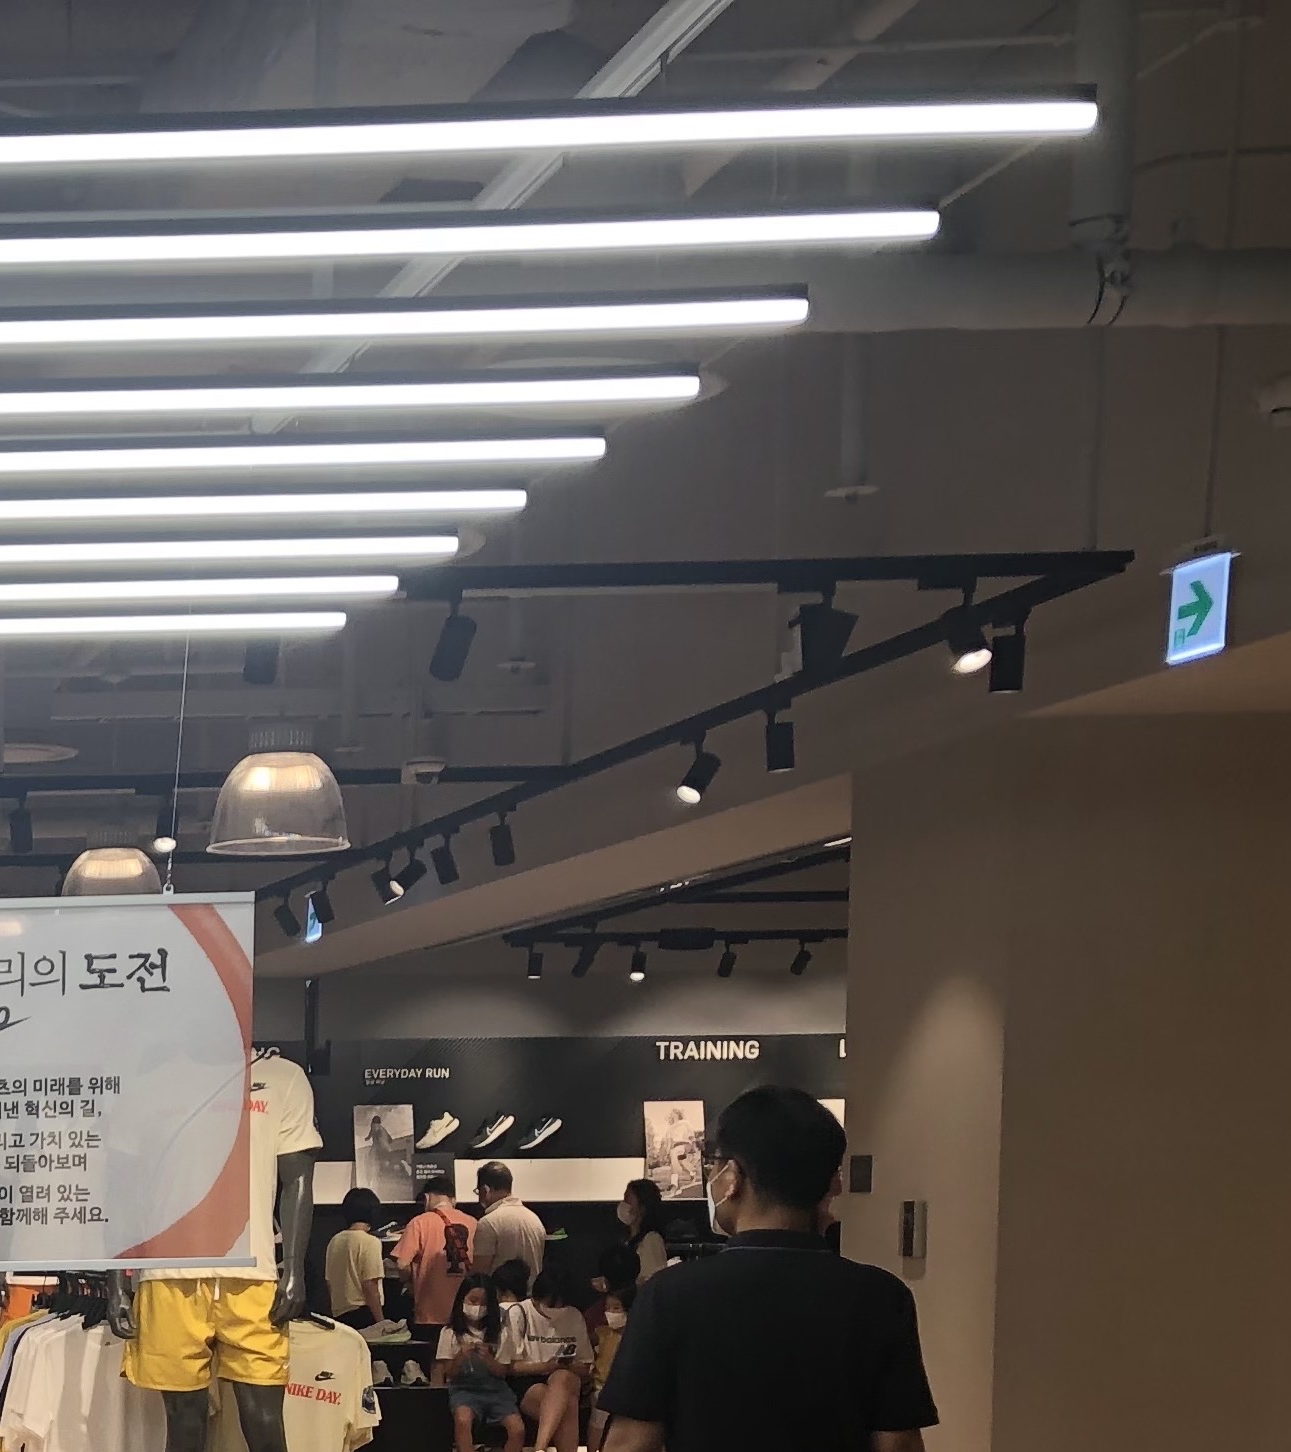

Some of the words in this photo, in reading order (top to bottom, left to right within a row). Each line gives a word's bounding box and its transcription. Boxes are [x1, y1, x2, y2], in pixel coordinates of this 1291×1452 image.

[79, 948, 171, 993] 도전
[655, 1040, 760, 1060] TRAINING
[364, 1068, 423, 1079] EVERYDAY
[425, 1067, 450, 1079] RUN
[33, 1077, 83, 1096] 미래를
[88, 1076, 120, 1095] 위해
[24, 1100, 74, 1118] 혁신의
[80, 1100, 102, 1118] 길,
[29, 1131, 62, 1149] 가치
[68, 1130, 101, 1148] 있는
[4, 1153, 87, 1173] 되돌아보며
[19, 1185, 51, 1203] 열려
[57, 1184, 90, 1202] 있는
[0, 1207, 48, 1226] 함께해
[53, 1206, 109, 1225] 주세요.
[285, 1383, 314, 1398] NIKE
[315, 1388, 342, 1406] DAY.
